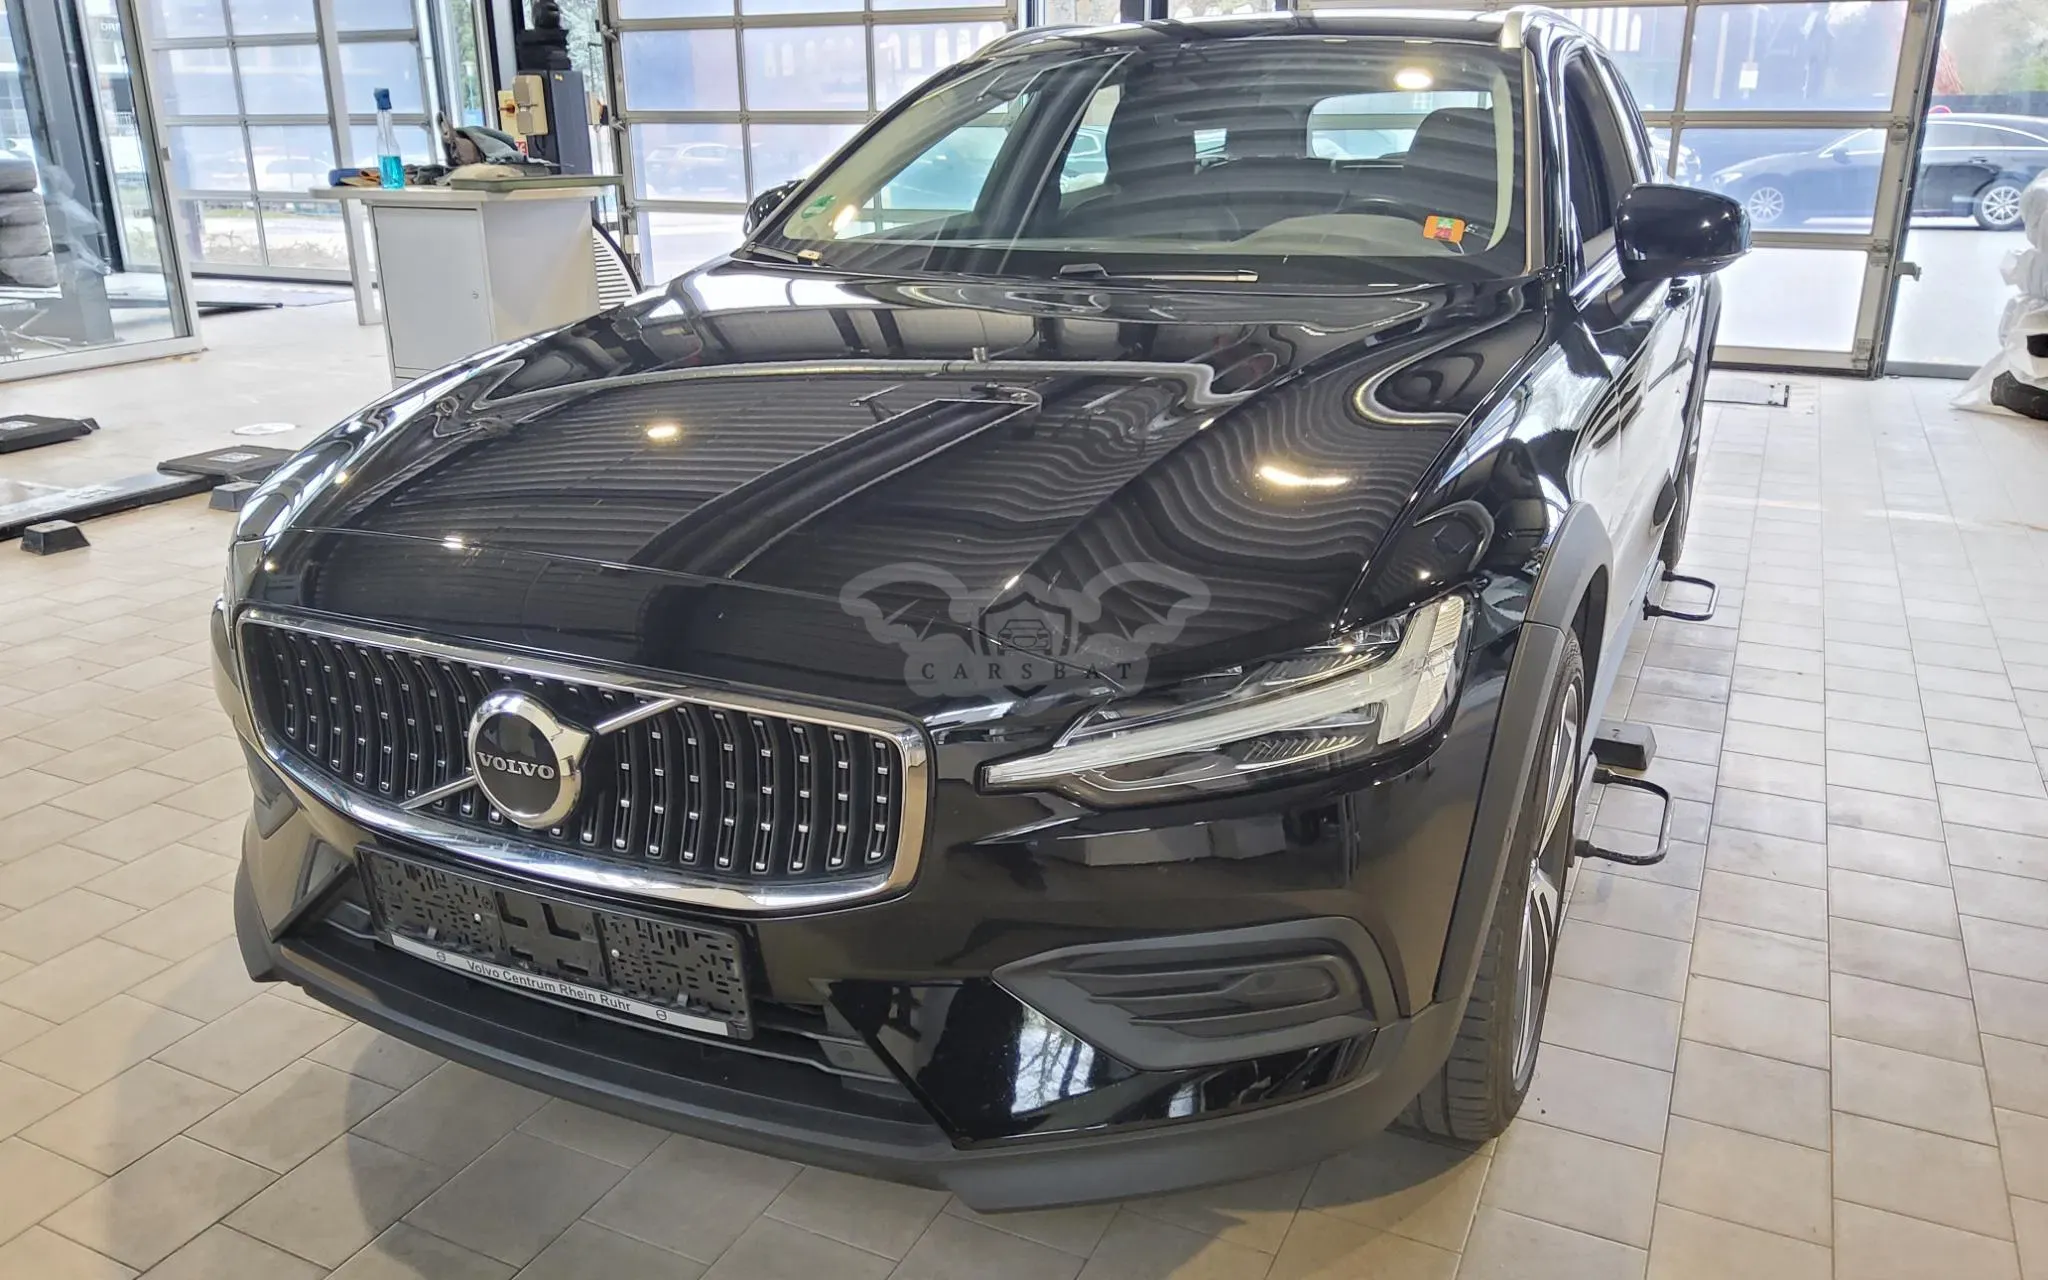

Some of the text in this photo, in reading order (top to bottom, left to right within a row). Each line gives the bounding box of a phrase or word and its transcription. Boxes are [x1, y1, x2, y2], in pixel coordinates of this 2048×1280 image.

[477, 752, 554, 779] VOLVO
[466, 960, 631, 1011] Volvo Centrum Rhein Ruhr
